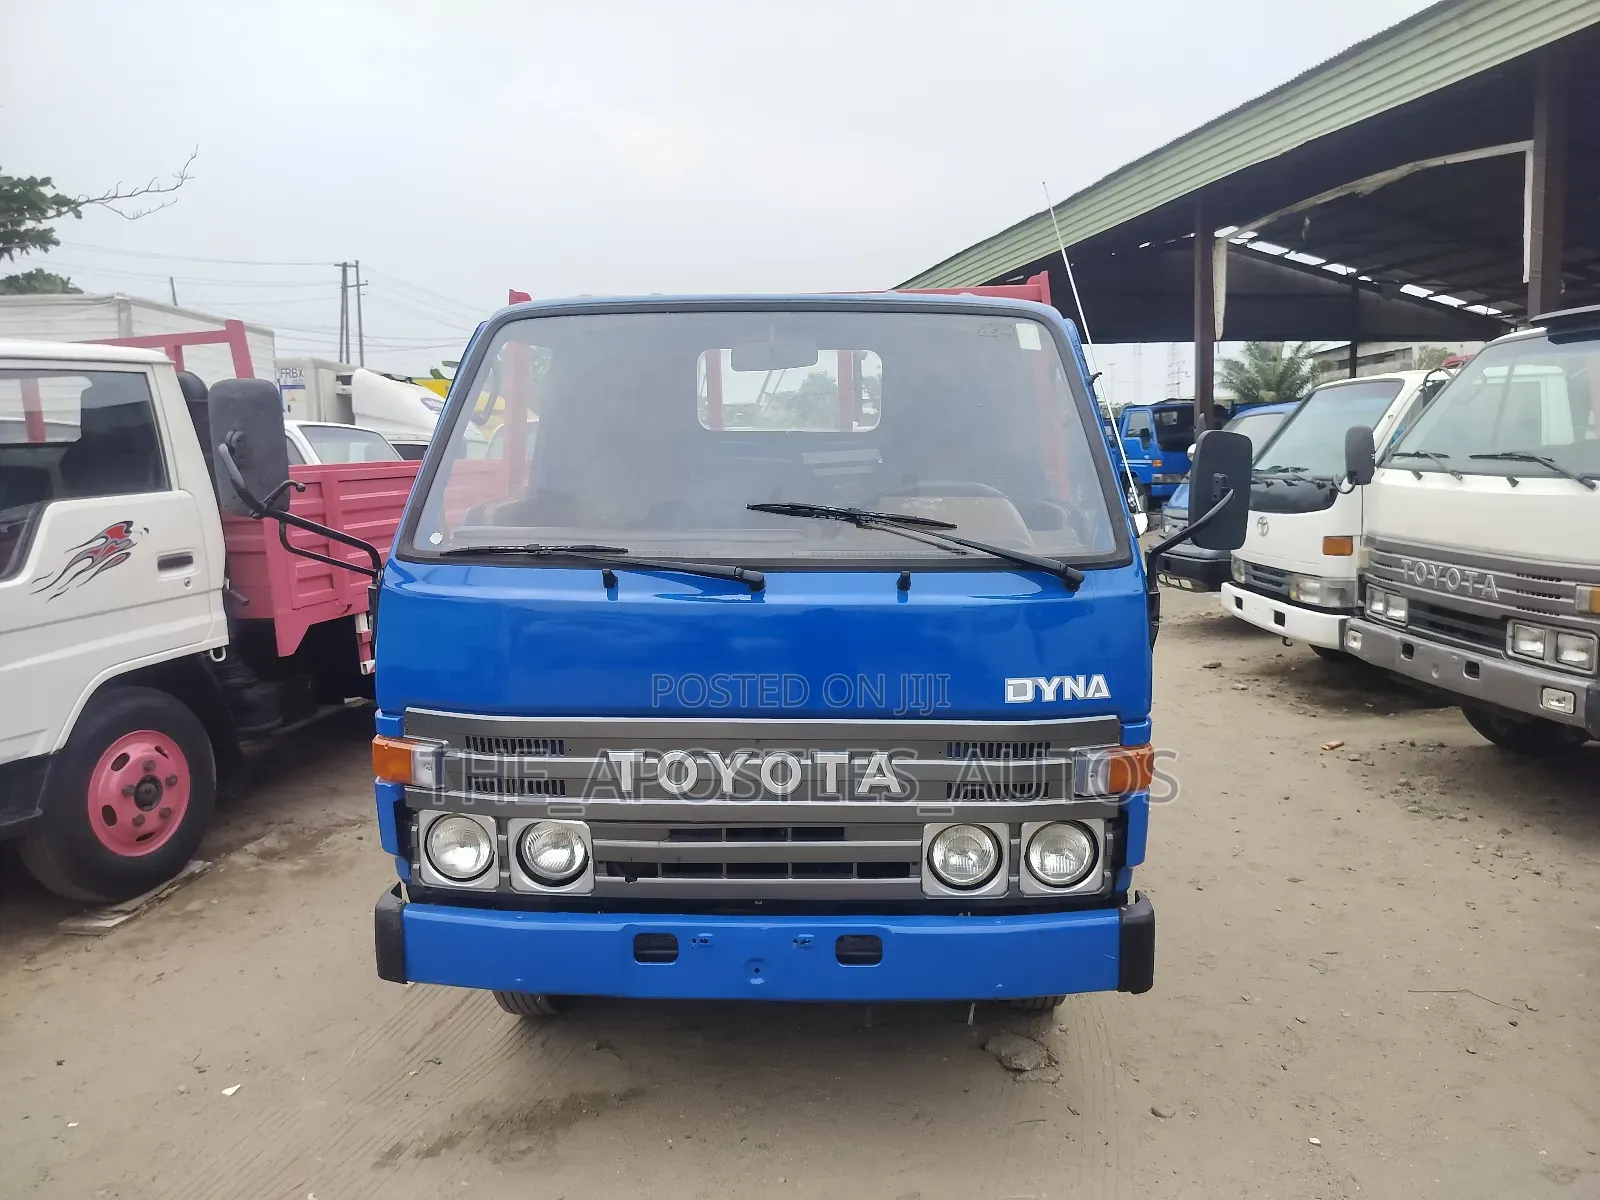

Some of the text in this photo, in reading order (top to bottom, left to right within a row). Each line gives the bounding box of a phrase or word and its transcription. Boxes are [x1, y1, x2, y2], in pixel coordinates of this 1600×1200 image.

[1400, 559, 1499, 600] TOYOTA
[1004, 674, 1111, 704] DYNA
[606, 750, 903, 796] TOYOTA
